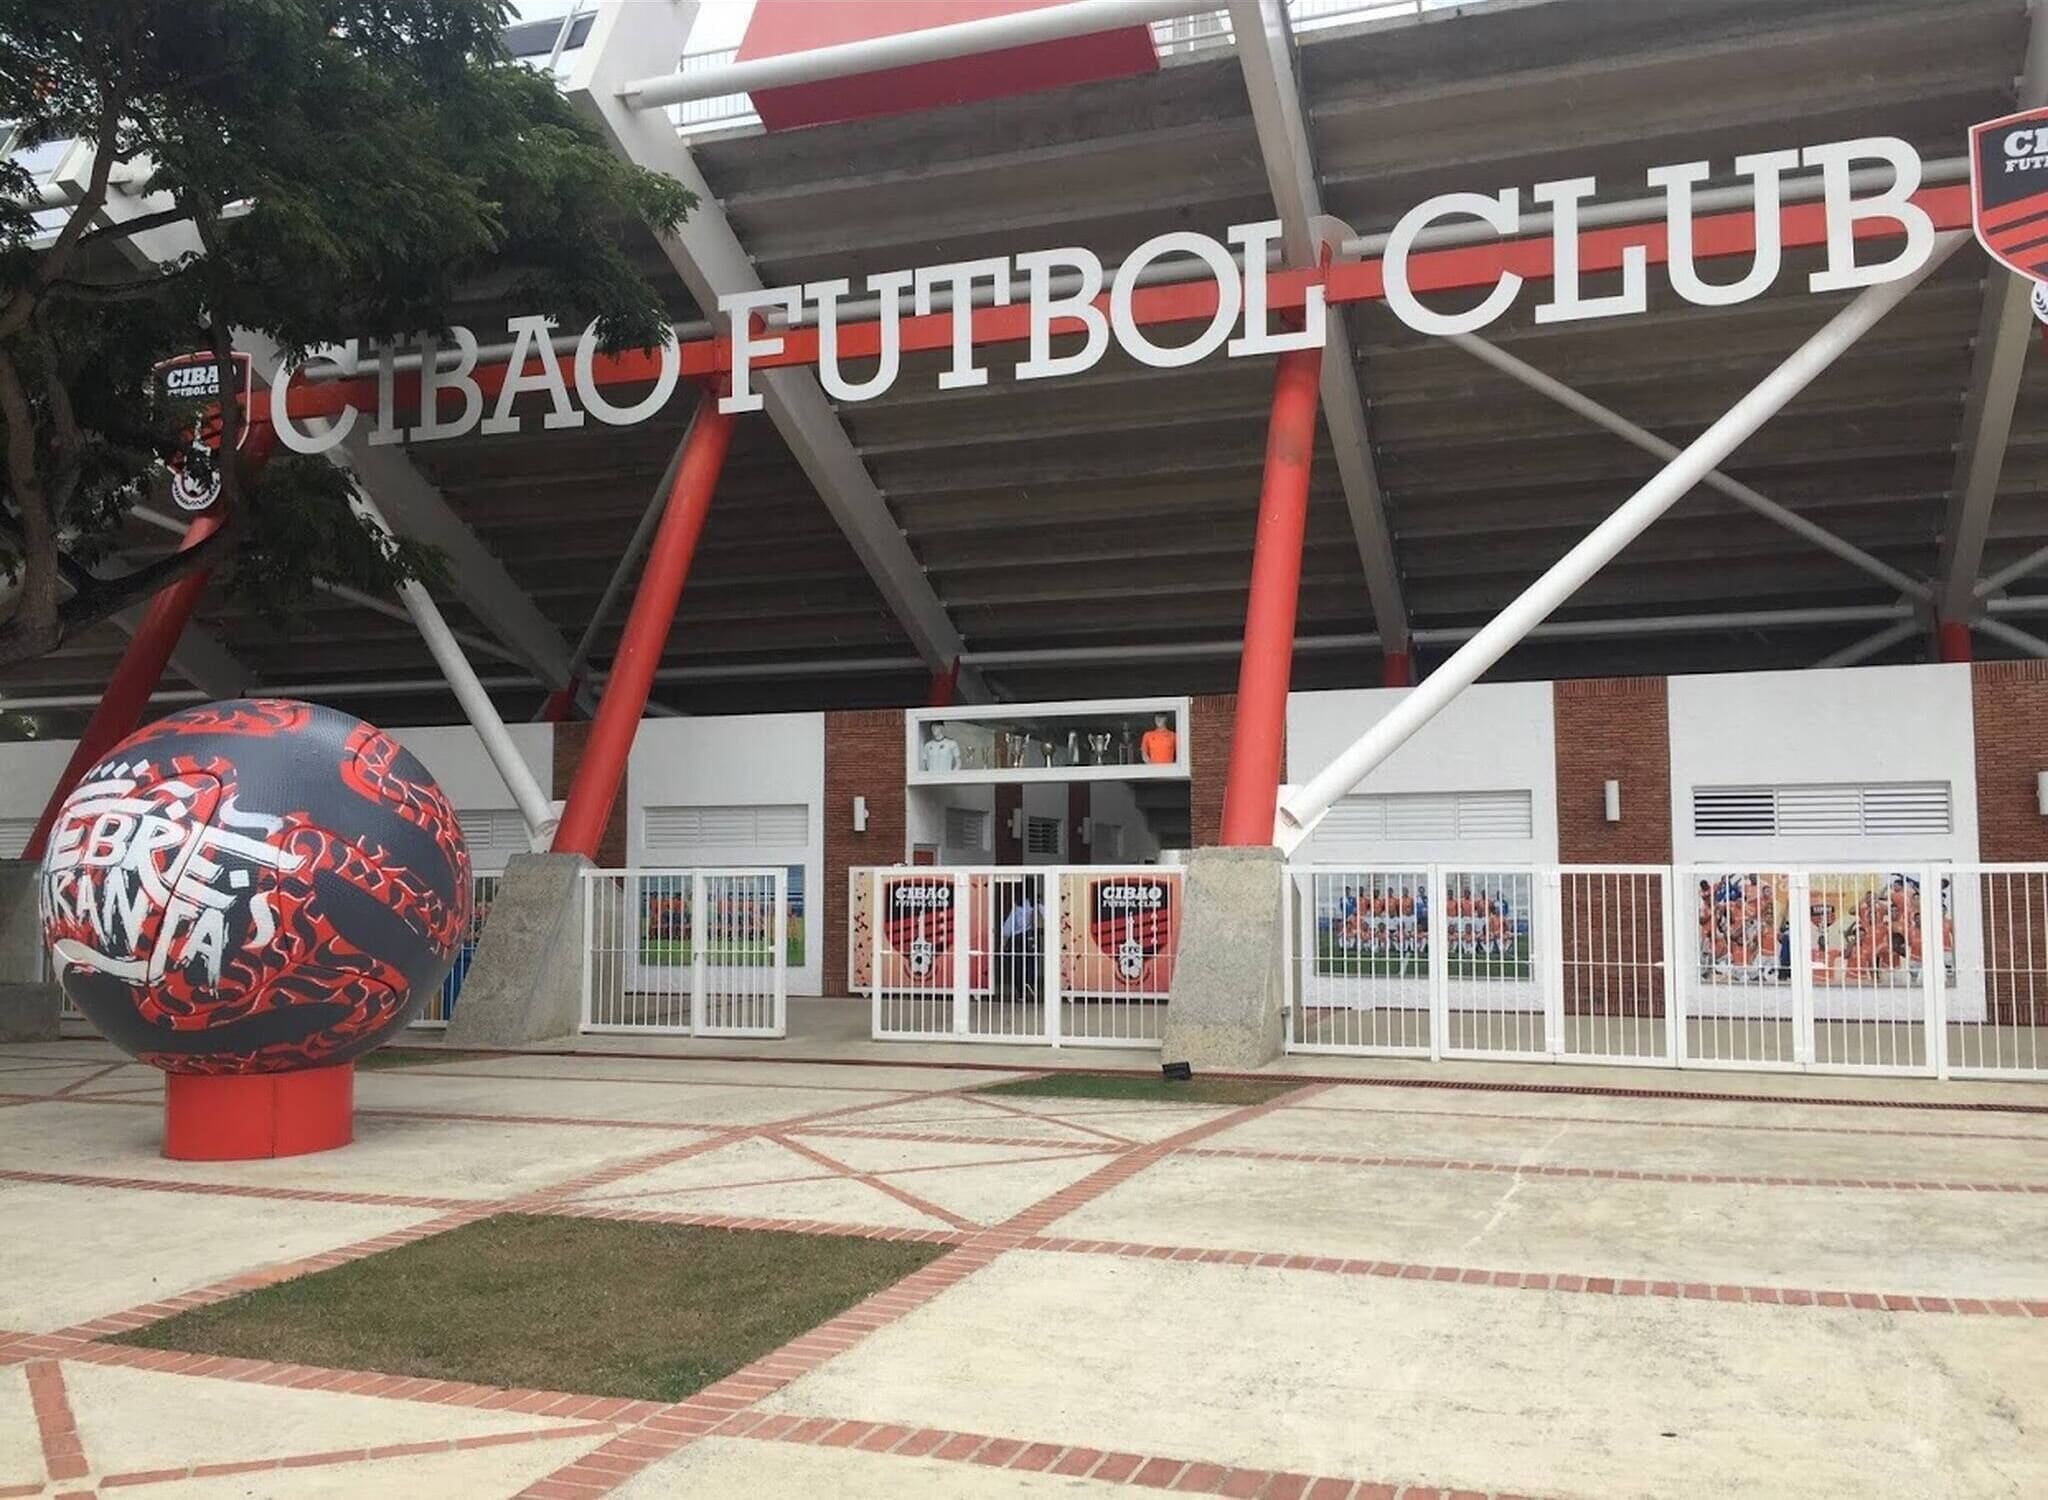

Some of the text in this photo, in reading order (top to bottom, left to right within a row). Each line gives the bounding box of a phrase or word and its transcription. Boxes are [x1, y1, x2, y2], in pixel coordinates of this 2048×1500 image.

[270, 136, 1936, 454] CIBAO FUTBOL CLUB
[167, 365, 237, 388] CIBA
[895, 887, 950, 899] CIBAO
[1102, 886, 1162, 900] CIBAO
